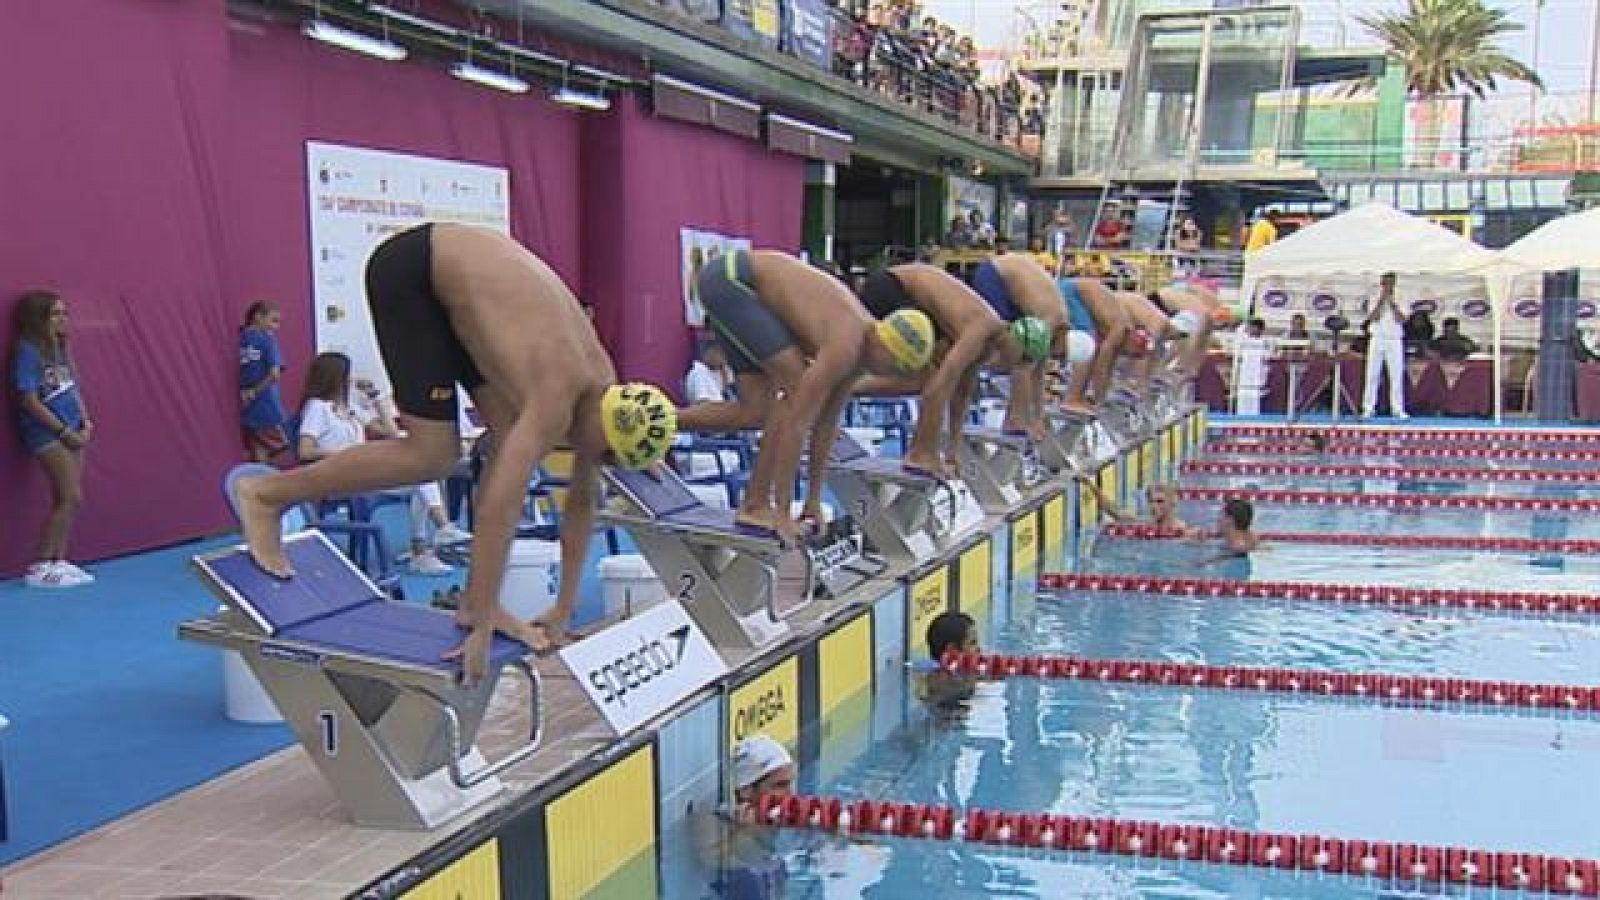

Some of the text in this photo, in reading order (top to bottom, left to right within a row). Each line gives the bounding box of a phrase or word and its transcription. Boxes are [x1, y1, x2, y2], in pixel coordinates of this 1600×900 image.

[680, 573, 696, 601] 2
[588, 635, 674, 707] speedo
[320, 712, 336, 753] 1
[734, 684, 784, 741] OMEGA
